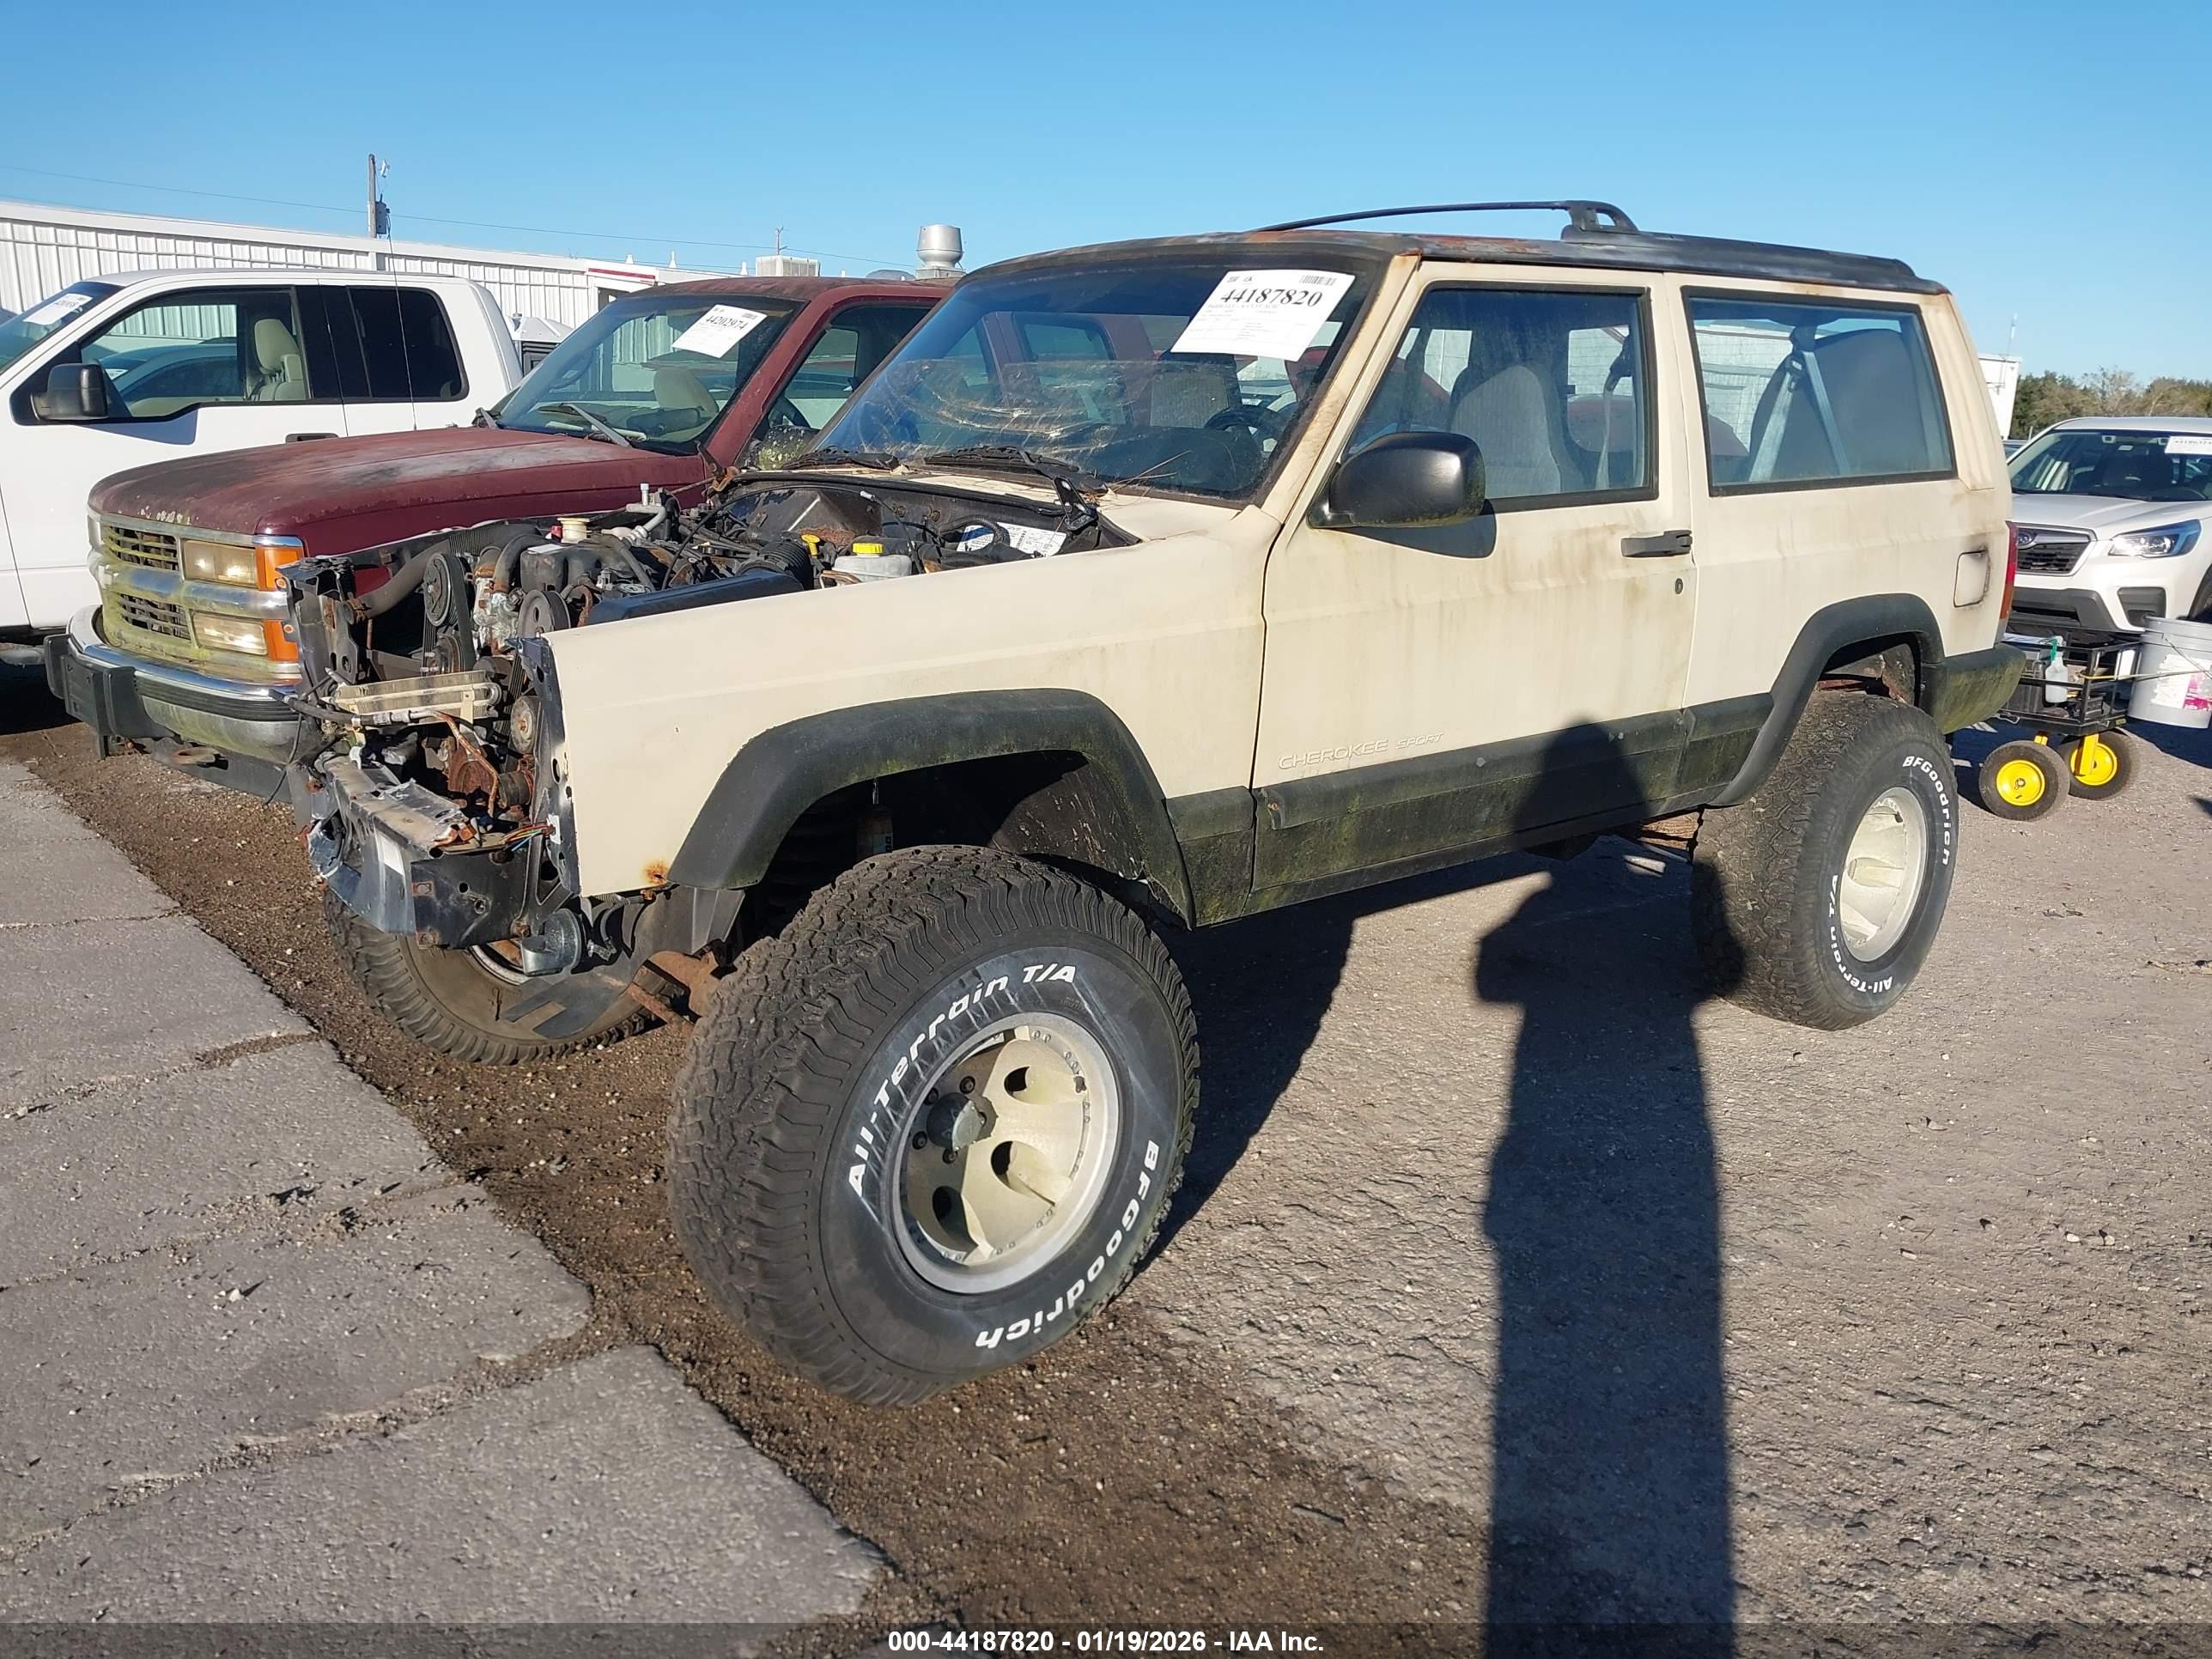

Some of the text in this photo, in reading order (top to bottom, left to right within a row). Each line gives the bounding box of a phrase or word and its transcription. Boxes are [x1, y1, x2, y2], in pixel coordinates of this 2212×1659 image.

[1221, 288, 1323, 307] 44187820
[1278, 732, 1444, 770] CHEROKEE SPORT
[1902, 755, 1952, 866] BFGoodrich
[1830, 927, 1893, 994] All-Terrain
[848, 963, 1077, 1198] All-Terrain T/A
[975, 1139, 1160, 1350] BFGoodrich
